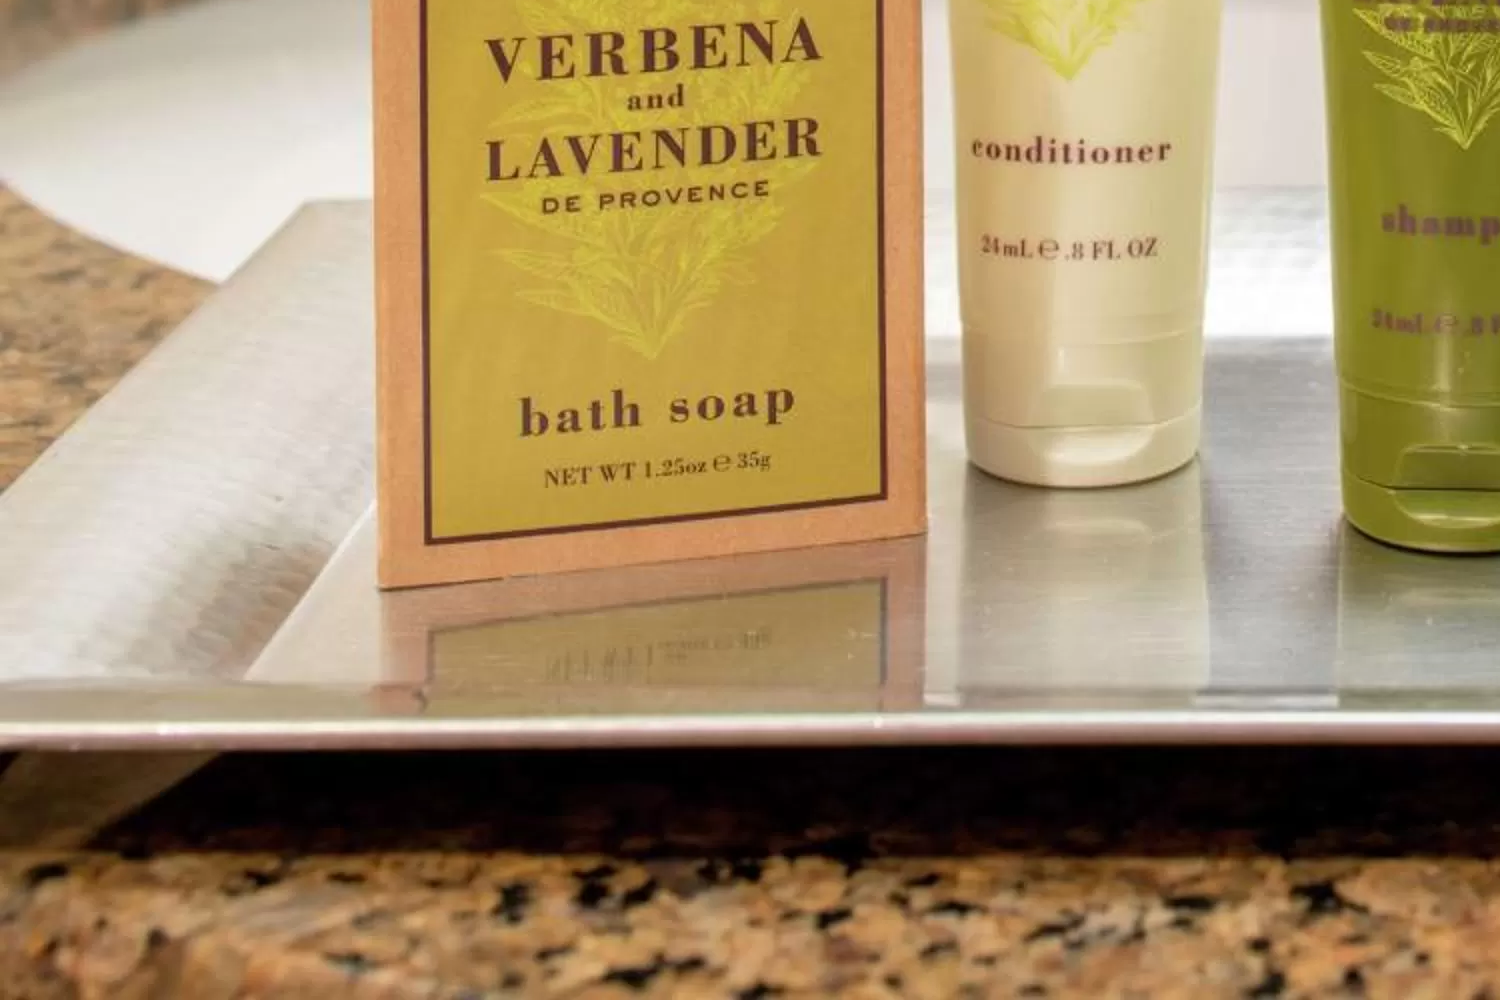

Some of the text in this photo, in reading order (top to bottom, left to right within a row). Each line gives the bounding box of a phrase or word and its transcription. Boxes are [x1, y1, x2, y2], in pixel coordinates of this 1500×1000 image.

[484, 16, 823, 84] VERBENA
[626, 84, 686, 111] and
[485, 117, 823, 182] LAVENDER
[971, 136, 1173, 165] conditioner
[541, 179, 770, 214] DE PROVENCE
[1127, 236, 1159, 258] OZ
[519, 387, 795, 437] bath soap
[544, 464, 592, 489] NET
[599, 462, 638, 484] WT
[643, 456, 707, 479] 1.25oz
[737, 450, 772, 473] 35g
